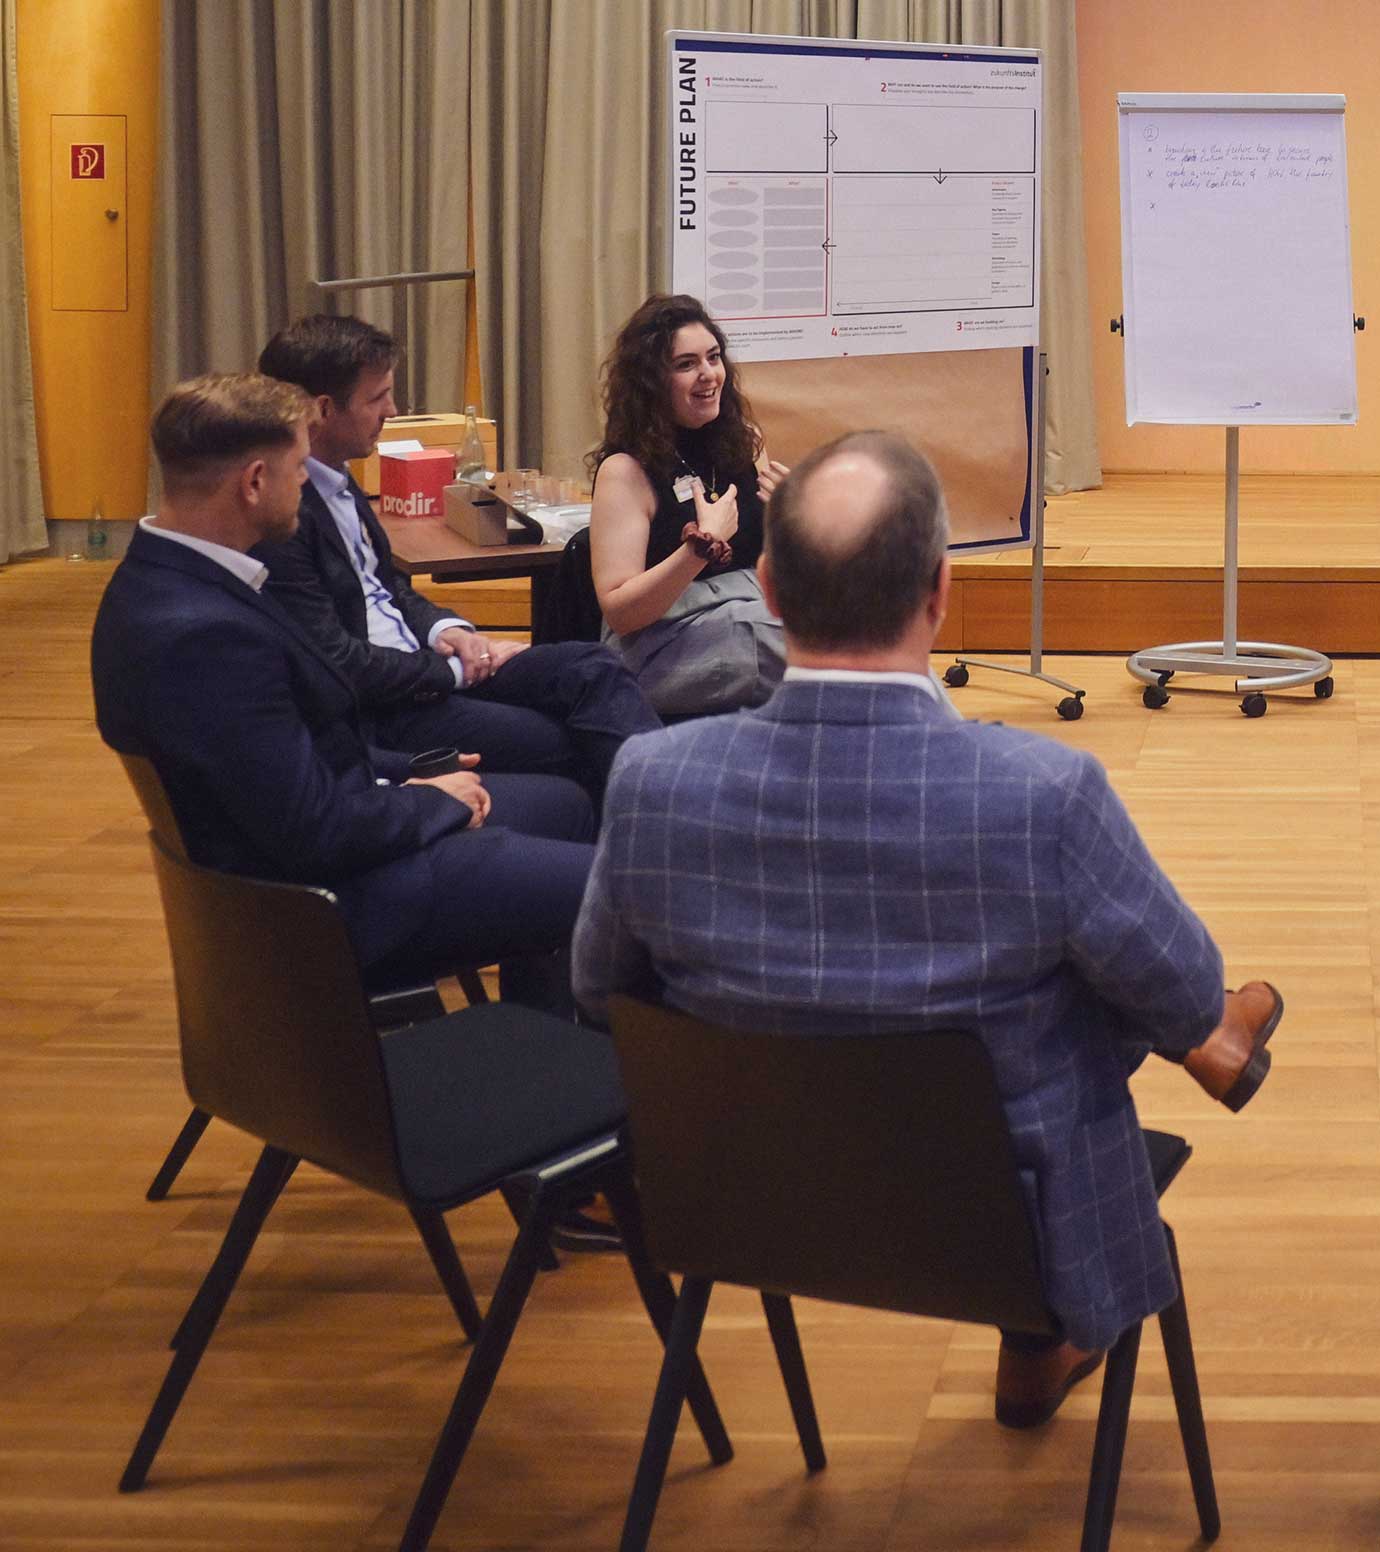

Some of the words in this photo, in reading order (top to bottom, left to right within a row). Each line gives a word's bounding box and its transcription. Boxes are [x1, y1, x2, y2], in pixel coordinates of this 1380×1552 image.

[705, 76, 711, 87] 1
[679, 57, 697, 123] PLAN
[881, 82, 887, 93] 2
[679, 132, 697, 231] FUTURE
[956, 320, 962, 331] 3
[831, 327, 838, 337] 4
[383, 491, 436, 517] prodir
